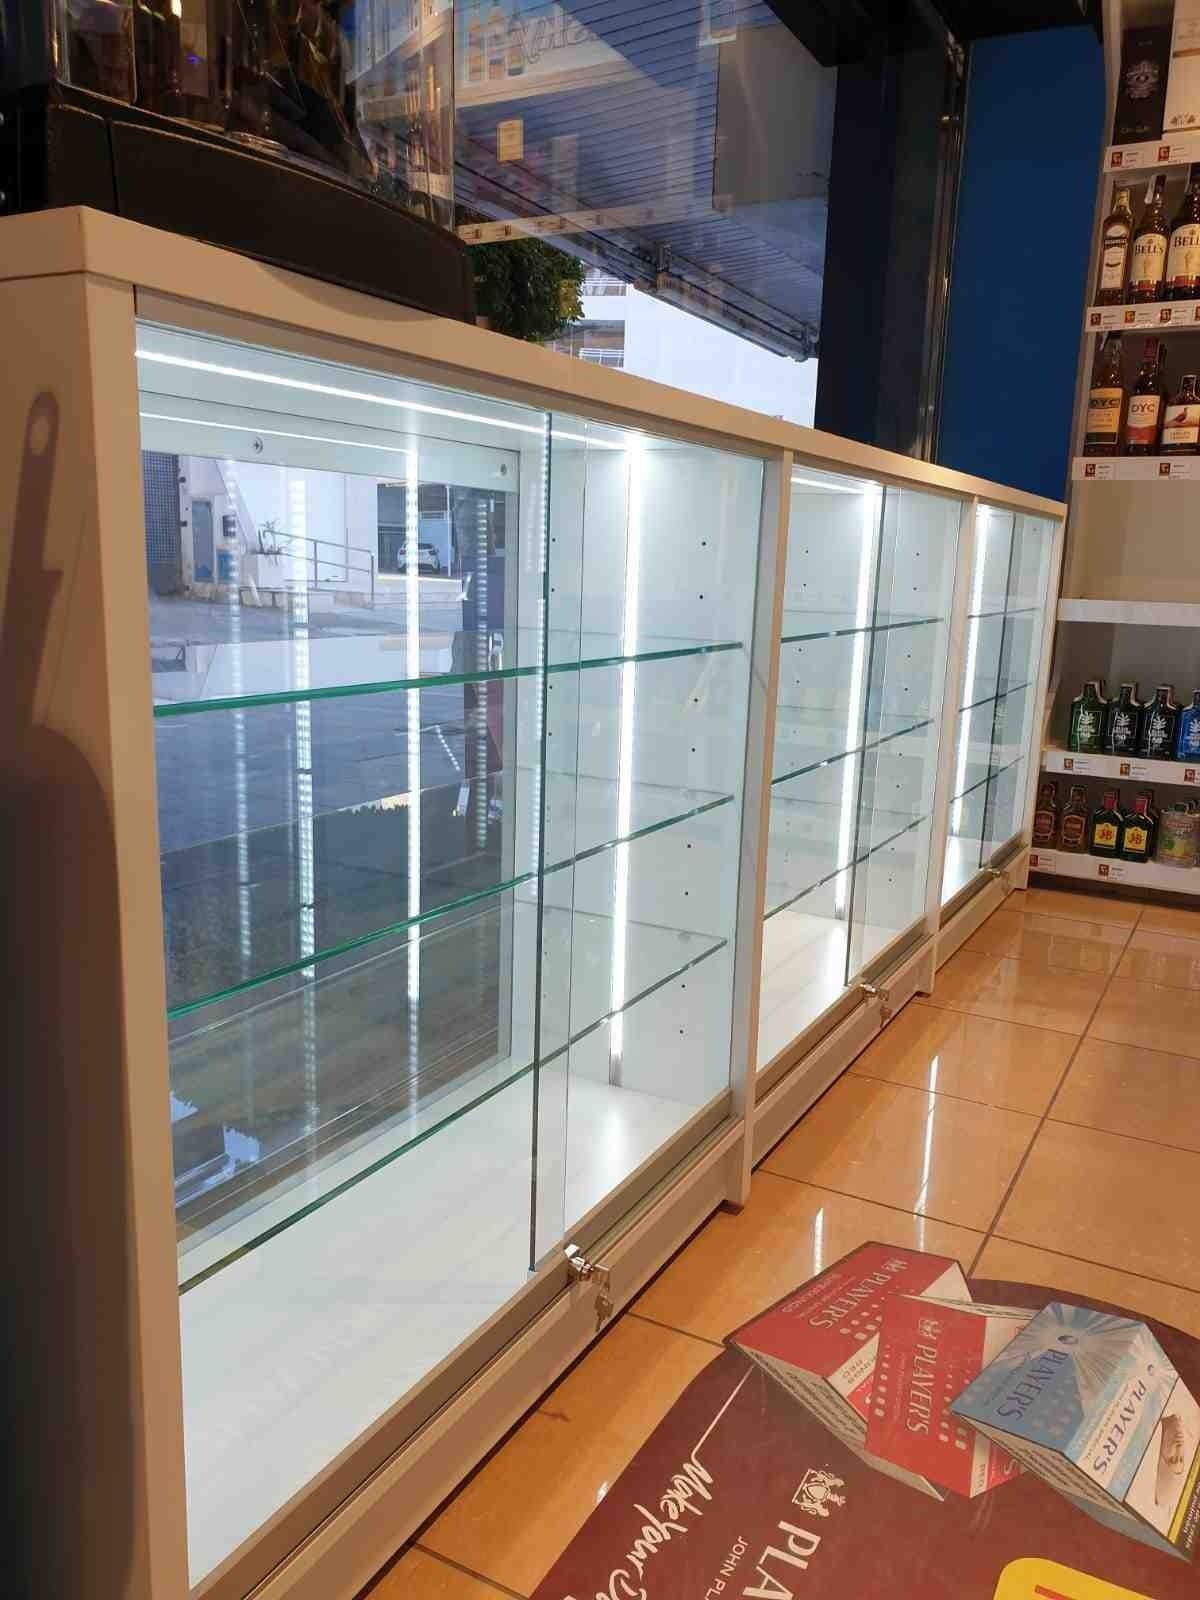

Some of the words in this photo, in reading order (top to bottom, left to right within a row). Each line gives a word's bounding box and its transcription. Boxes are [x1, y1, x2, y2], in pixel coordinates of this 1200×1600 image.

[1090, 398, 1120, 408] DYC
[1131, 403, 1155, 413] DYC
[808, 1271, 890, 1329] PLAYER'S
[905, 1344, 937, 1436] PLAYER'S
[997, 1348, 1067, 1420] PLAYER'S
[1092, 1377, 1146, 1475] PLAYER'S
[660, 1452, 713, 1520] Make
[627, 1503, 688, 1581] Your
[719, 1535, 749, 1577] JOHN
[704, 1578, 726, 1600] PL
